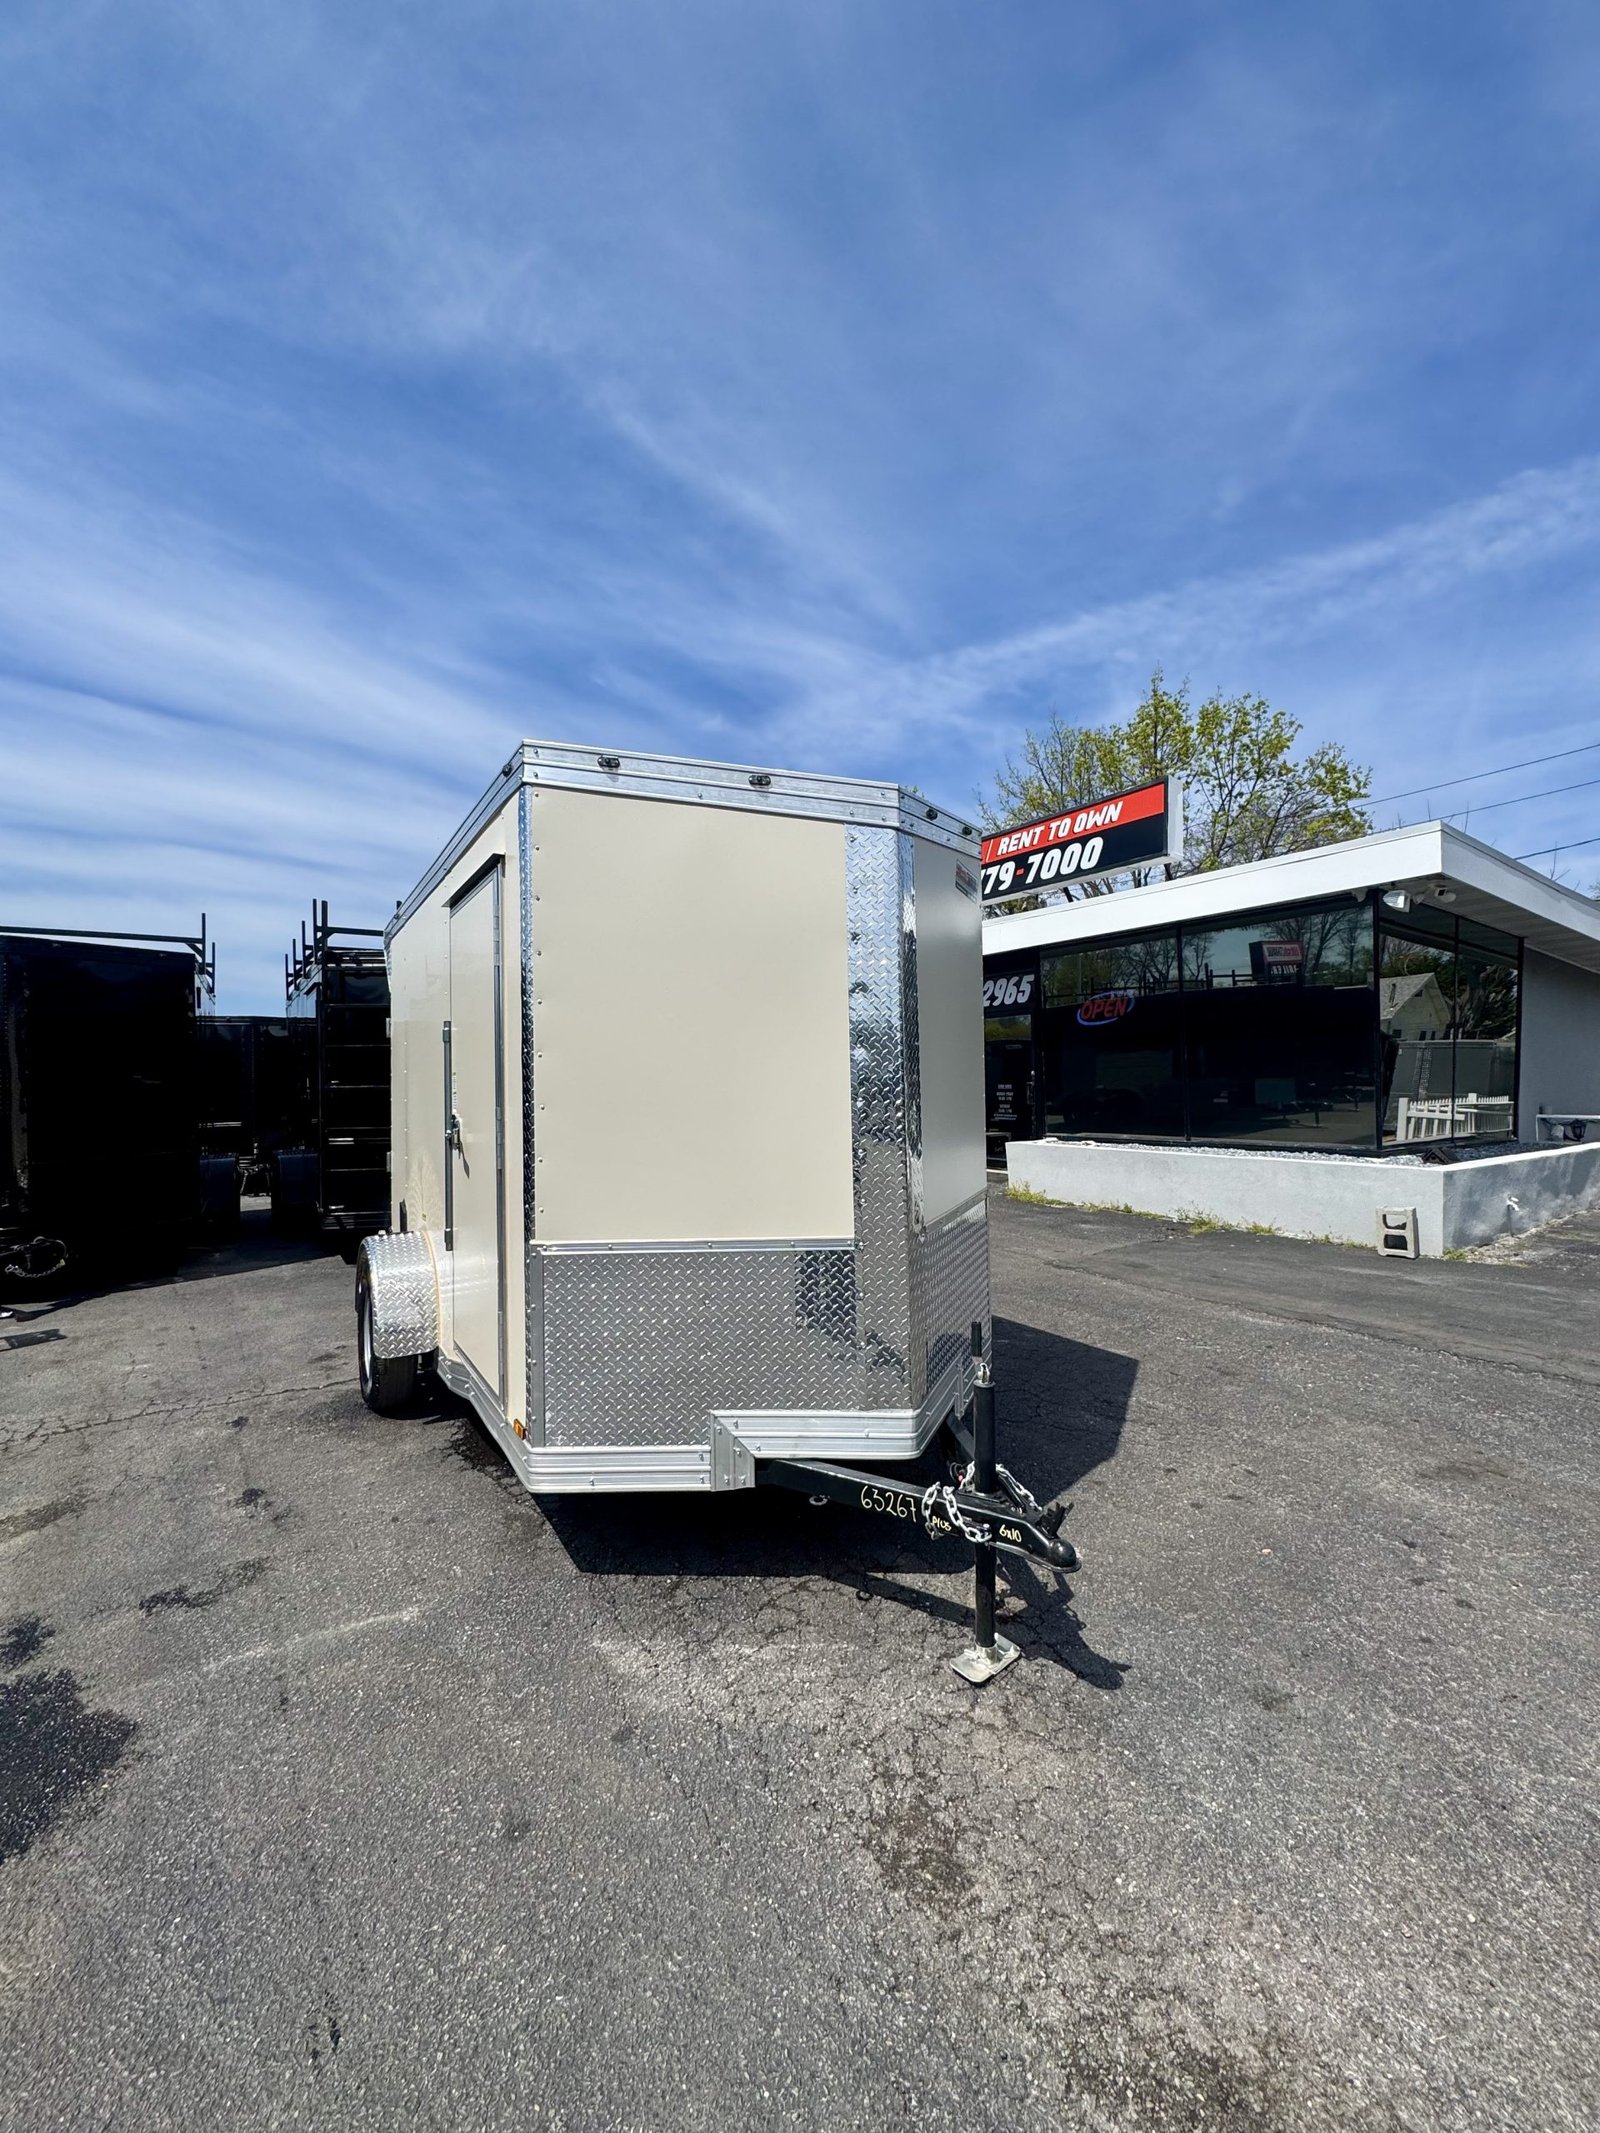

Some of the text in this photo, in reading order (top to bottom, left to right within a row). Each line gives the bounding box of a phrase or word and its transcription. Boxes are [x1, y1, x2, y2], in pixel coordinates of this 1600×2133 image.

[997, 801, 1123, 856] RENT TO OWN
[983, 974, 1035, 1007] 2965
[1081, 997, 1128, 1020] OPEN
[860, 1485, 917, 1523] 63267
